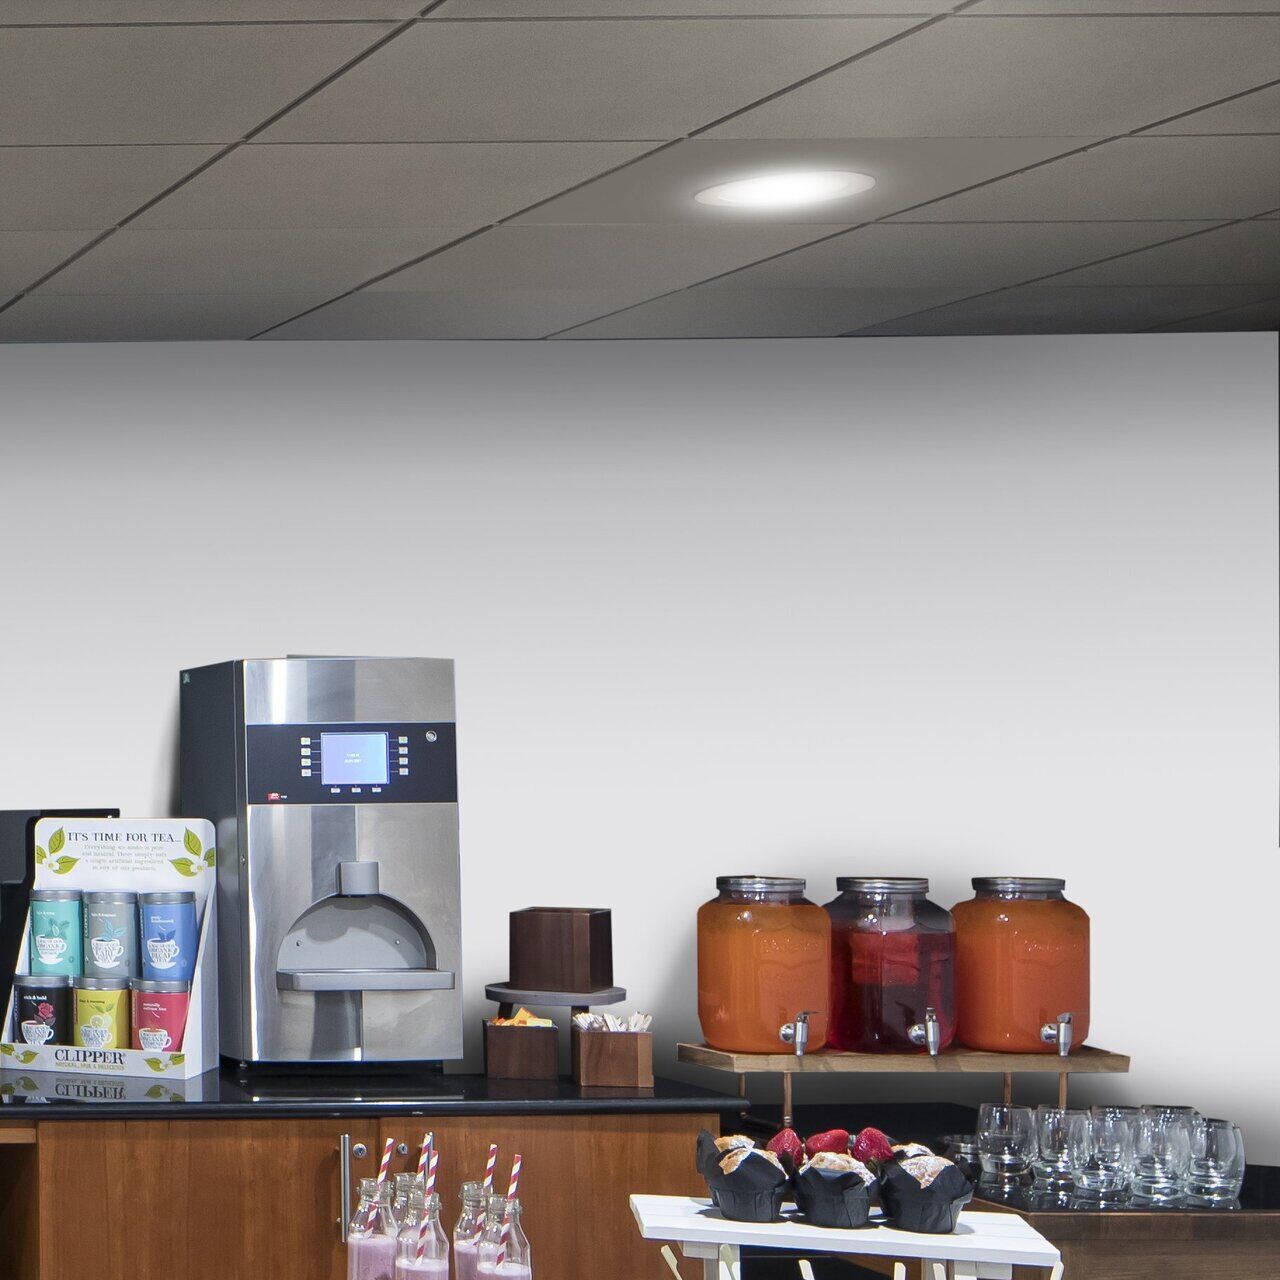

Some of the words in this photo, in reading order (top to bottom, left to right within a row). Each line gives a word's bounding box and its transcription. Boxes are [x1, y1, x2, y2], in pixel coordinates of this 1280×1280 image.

[68, 832, 89, 842] IT'S
[92, 832, 122, 842] TIME
[126, 833, 147, 843] FOR
[55, 1048, 124, 1065] CLIPPER
